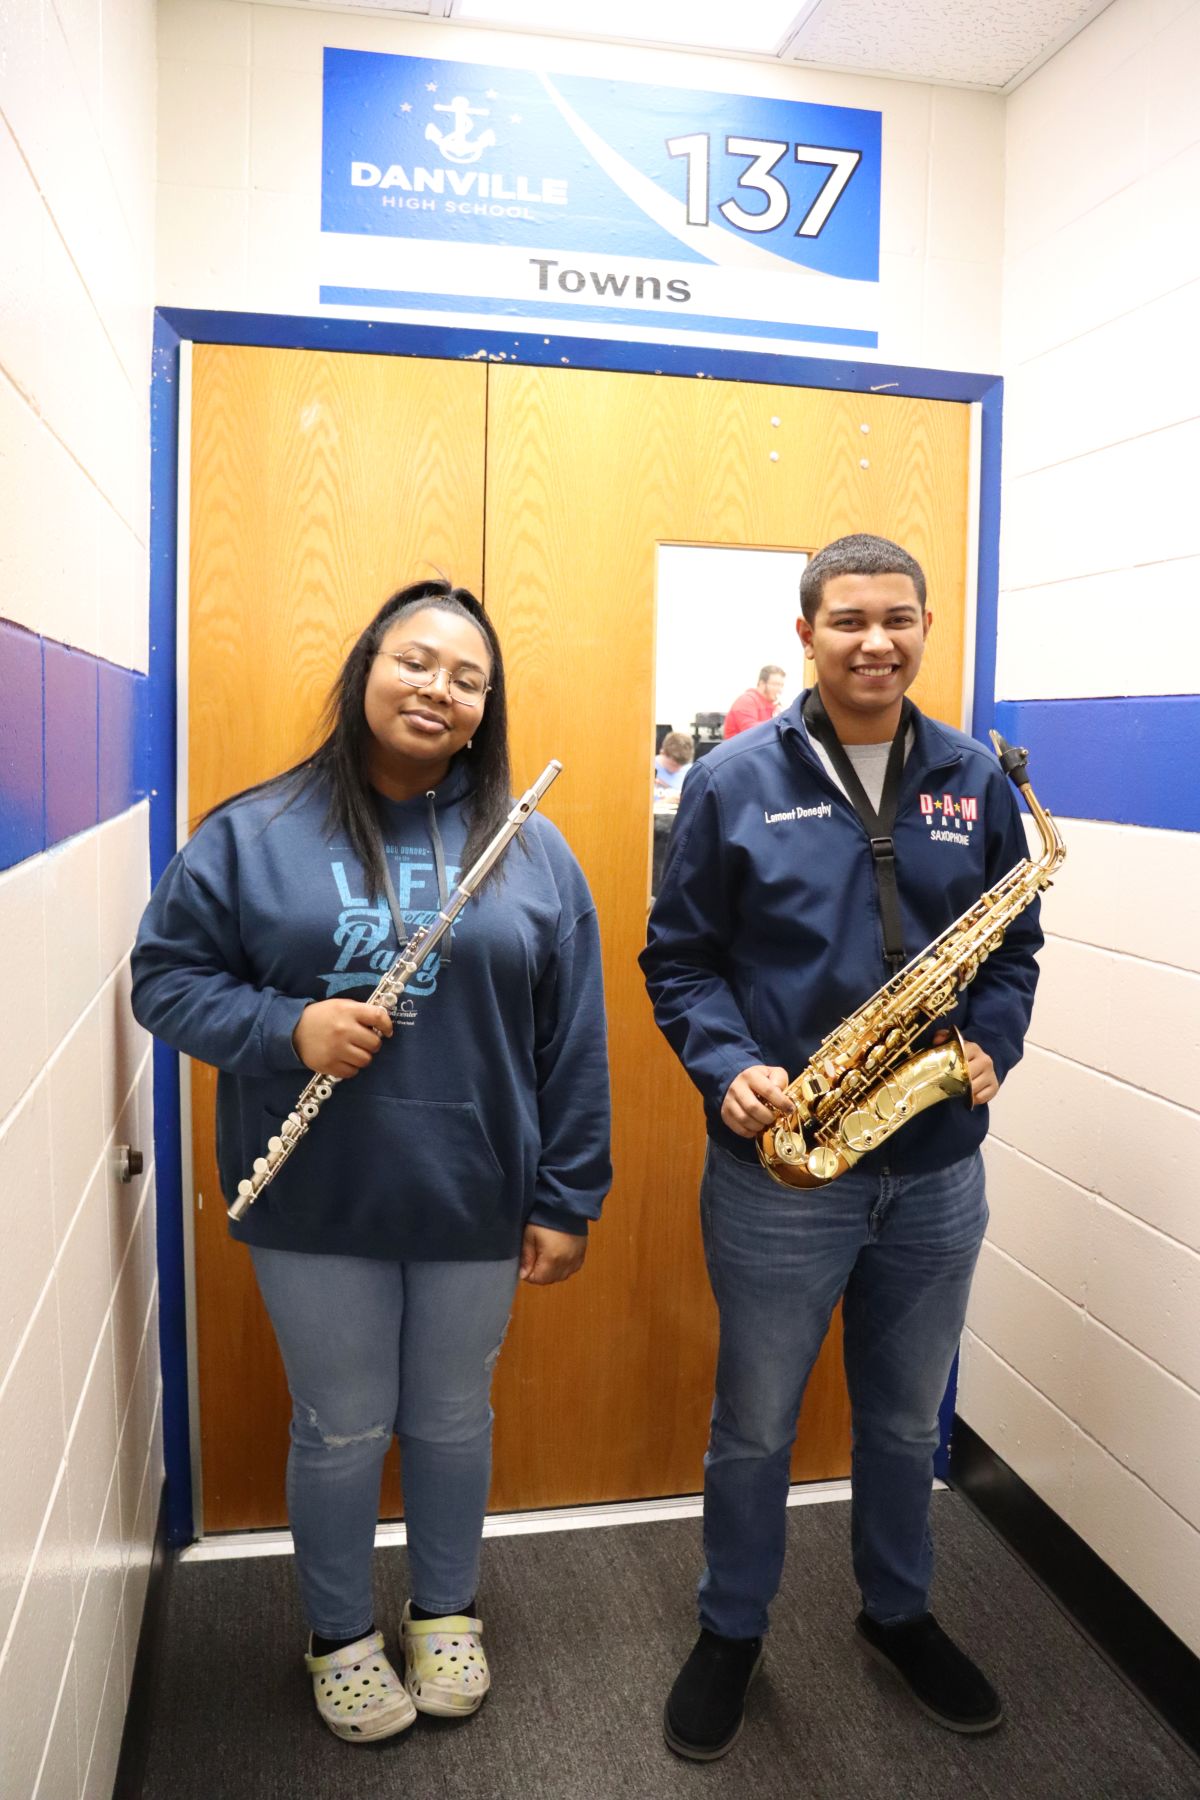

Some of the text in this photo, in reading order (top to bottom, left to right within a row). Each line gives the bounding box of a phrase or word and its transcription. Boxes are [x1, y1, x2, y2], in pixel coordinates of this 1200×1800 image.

[351, 161, 568, 205] DANVILLE
[665, 132, 863, 239] 137
[382, 195, 535, 219] HIGH SCHOOL
[529, 258, 692, 303] Towns
[764, 801, 832, 823] Lamont Doneghy
[930, 830, 970, 846] SAXOPHONE
[331, 862, 466, 909] LF
